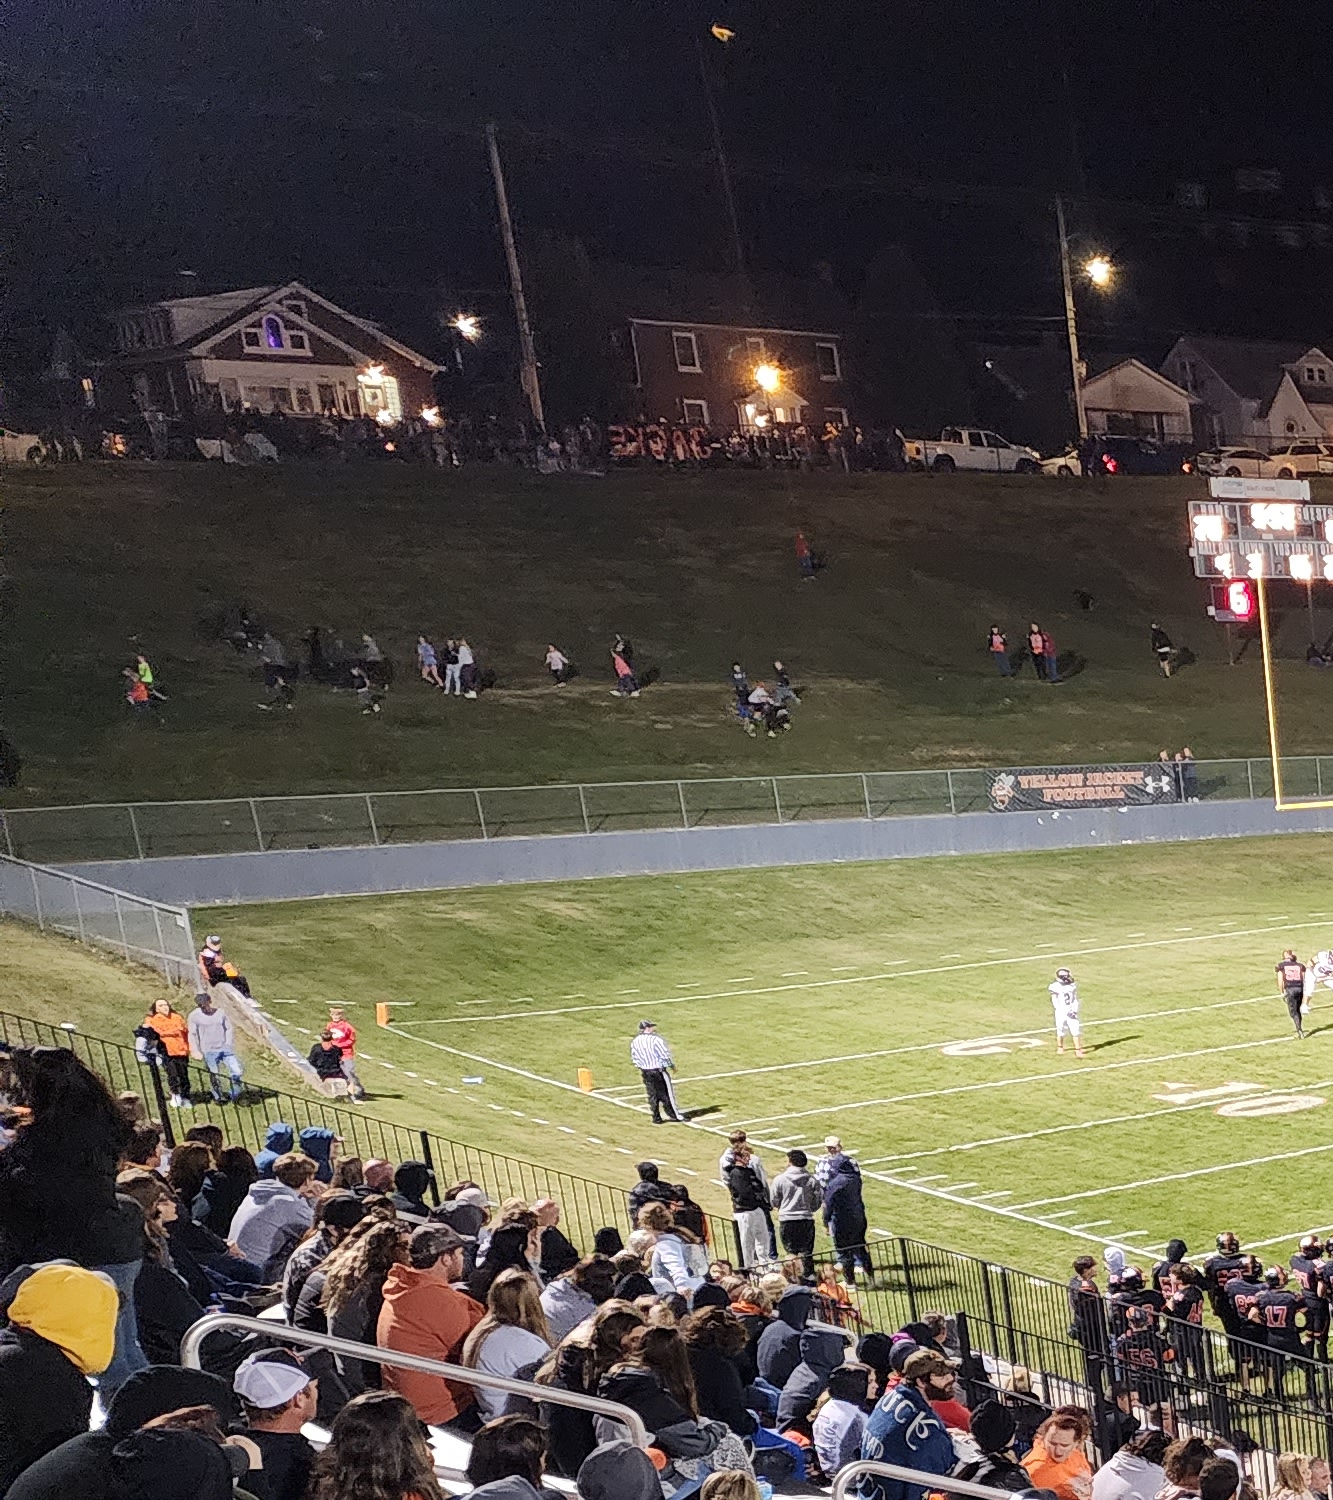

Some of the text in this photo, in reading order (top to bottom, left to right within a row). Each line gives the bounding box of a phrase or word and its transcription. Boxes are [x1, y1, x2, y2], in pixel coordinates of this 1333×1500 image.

[1017, 770, 1145, 788] YELLOW JACKET
[1042, 785, 1126, 801] FOOTBALL
[1264, 1305, 1288, 1328] 17
